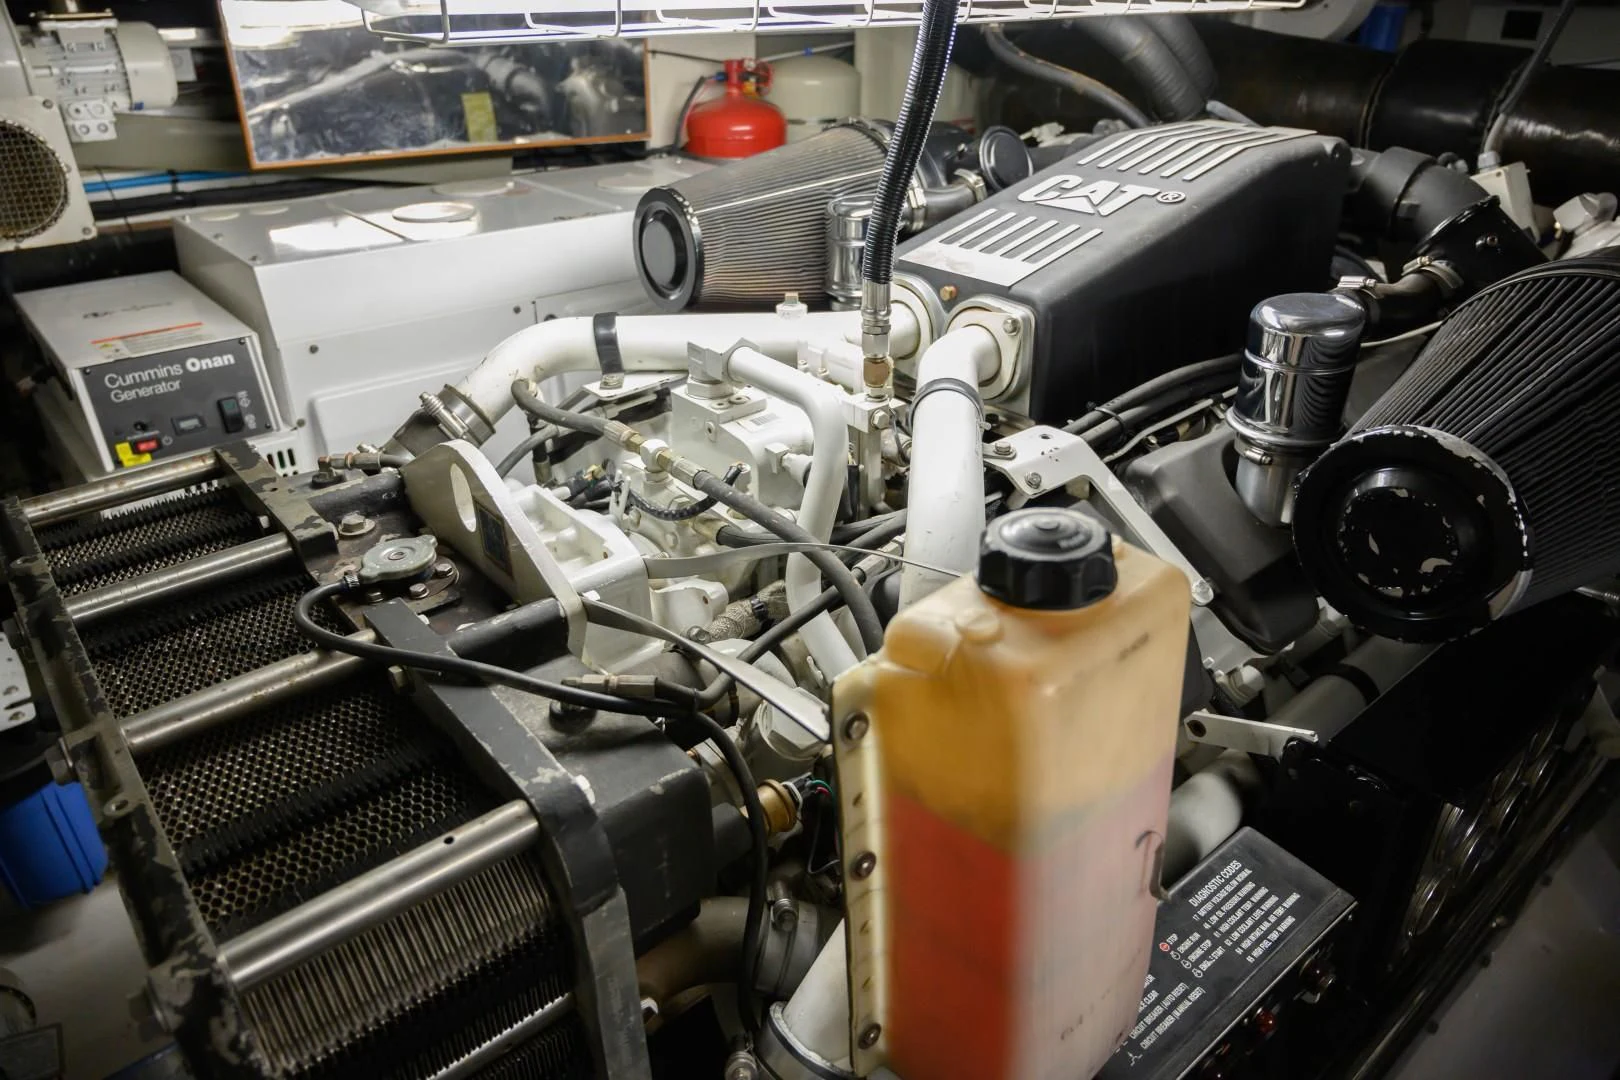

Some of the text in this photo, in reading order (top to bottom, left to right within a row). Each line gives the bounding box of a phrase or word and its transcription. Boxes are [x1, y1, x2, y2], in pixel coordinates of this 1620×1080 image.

[104, 353, 236, 389] Cummins Onan
[110, 379, 181, 403] Generator
[1188, 860, 1242, 907] DIAGNOSTIC CODES
[1197, 901, 1215, 917] BATTERY
[1211, 888, 1228, 904] VOLTAGE
[1224, 879, 1239, 893] BELOW
[1235, 868, 1252, 883] NORMAL
[1208, 914, 1219, 925] LOW
[1221, 894, 1242, 912] PRESSURE
[1237, 882, 1256, 897] WARNING
[1218, 922, 1231, 933] HIGH
[1226, 908, 1245, 926] COOLANT
[1250, 886, 1269, 903] WARNING
[1229, 931, 1241, 941] LOW
[1237, 917, 1255, 934] COOLANT
[1251, 908, 1265, 921] LEVEL
[1260, 894, 1279, 911] WARNING
[1240, 938, 1253, 950] HIGH
[1281, 892, 1301, 909] WARNING
[1166, 933, 1178, 945] STOP
[1177, 931, 1201, 954] ENGINE RUN
[1188, 939, 1212, 962] ENGINE STOP
[1211, 945, 1225, 960] START
[1251, 946, 1263, 958] HIGH
[1276, 915, 1296, 933] WARNING
[1143, 990, 1159, 1005] CLEAR
[1129, 1020, 1148, 1039] CIRCUIT
[1143, 1005, 1164, 1025] BREAKER
[1140, 1030, 1159, 1049] CIRCUIT
[1154, 1014, 1176, 1035] BREAKER
